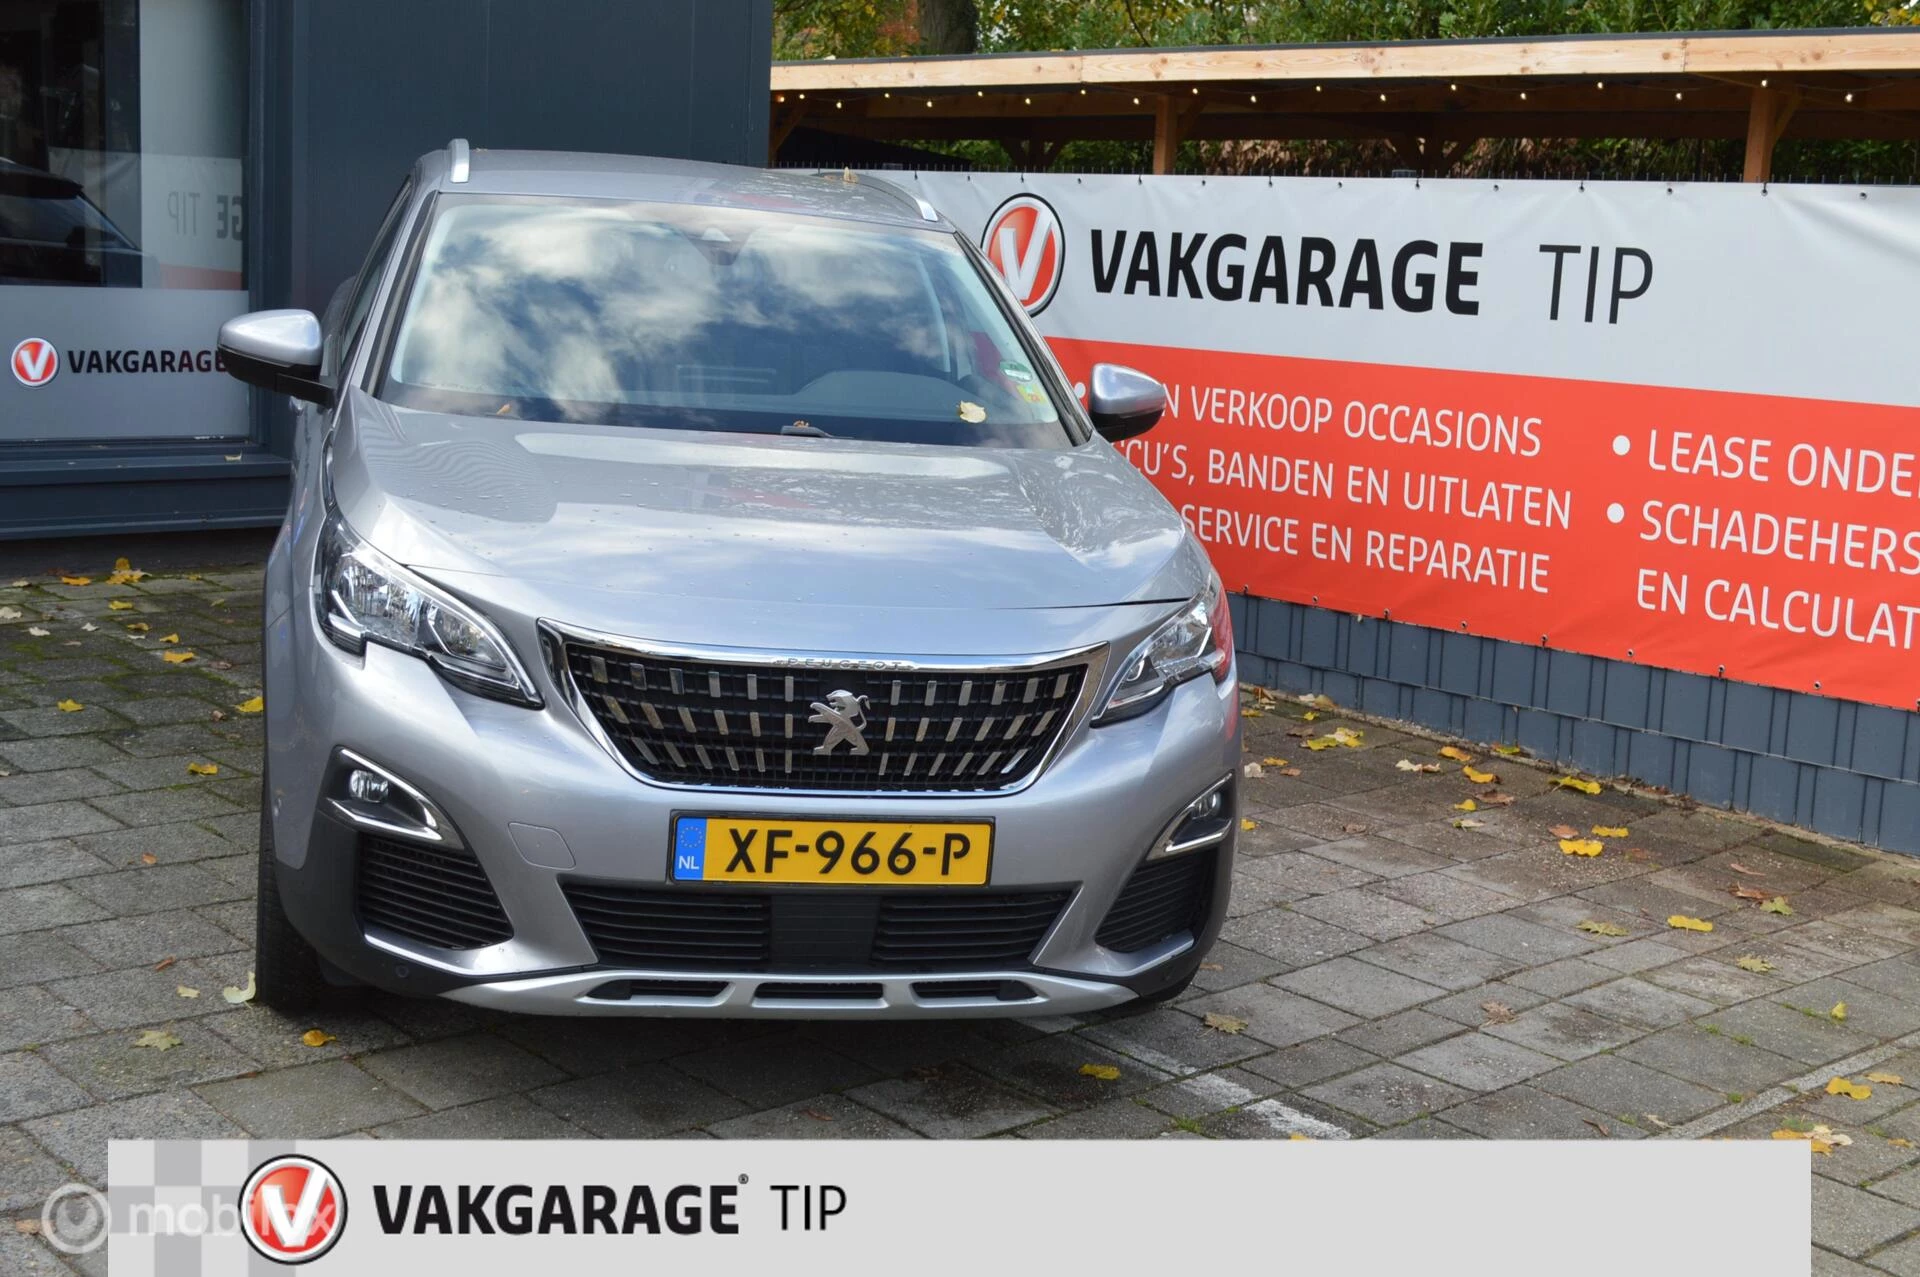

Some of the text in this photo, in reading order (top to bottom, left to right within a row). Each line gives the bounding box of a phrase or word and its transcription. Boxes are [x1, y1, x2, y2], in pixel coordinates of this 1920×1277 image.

[1091, 229, 1483, 316] VAKGARAGE
[1539, 244, 1653, 324] TIP
[1191, 385, 1333, 433] VERKOOP
[1344, 401, 1542, 457] OCCASIONS
[1111, 439, 1571, 530] CU'S, BANDEN EN UITLATEN
[1649, 429, 1920, 499] LEASE ONDE
[1181, 504, 1550, 593] SERVICE EN REPARATIE
[1640, 500, 1920, 575] SCHADEHERS
[1637, 568, 1920, 649] EN CALCULAT
[787, 657, 903, 671] PEUGEOT
[678, 827, 971, 876] NL XF-966-P
